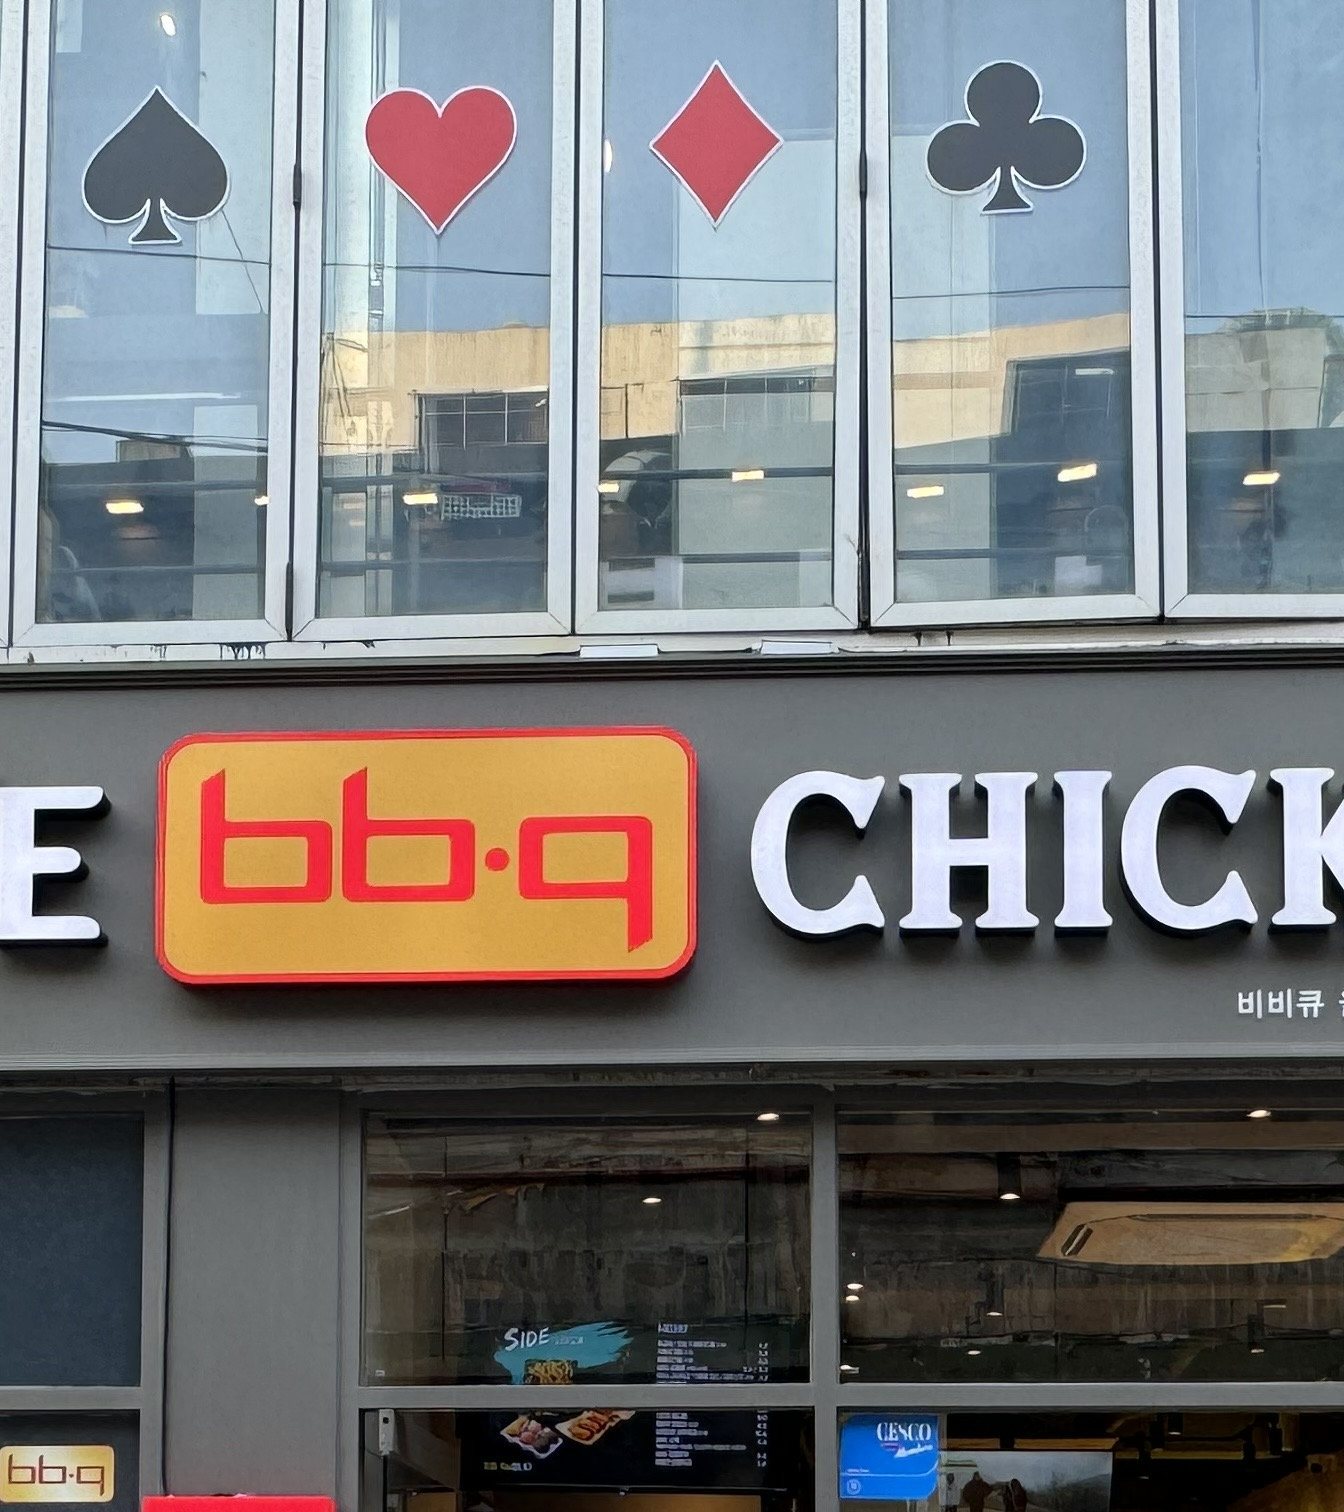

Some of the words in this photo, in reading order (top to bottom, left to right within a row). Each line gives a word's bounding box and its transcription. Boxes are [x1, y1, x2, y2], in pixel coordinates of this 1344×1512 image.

[1238, 988, 1324, 1019] 비비큐
[504, 1327, 550, 1351] SIDE
[877, 1422, 932, 1441] CESCO
